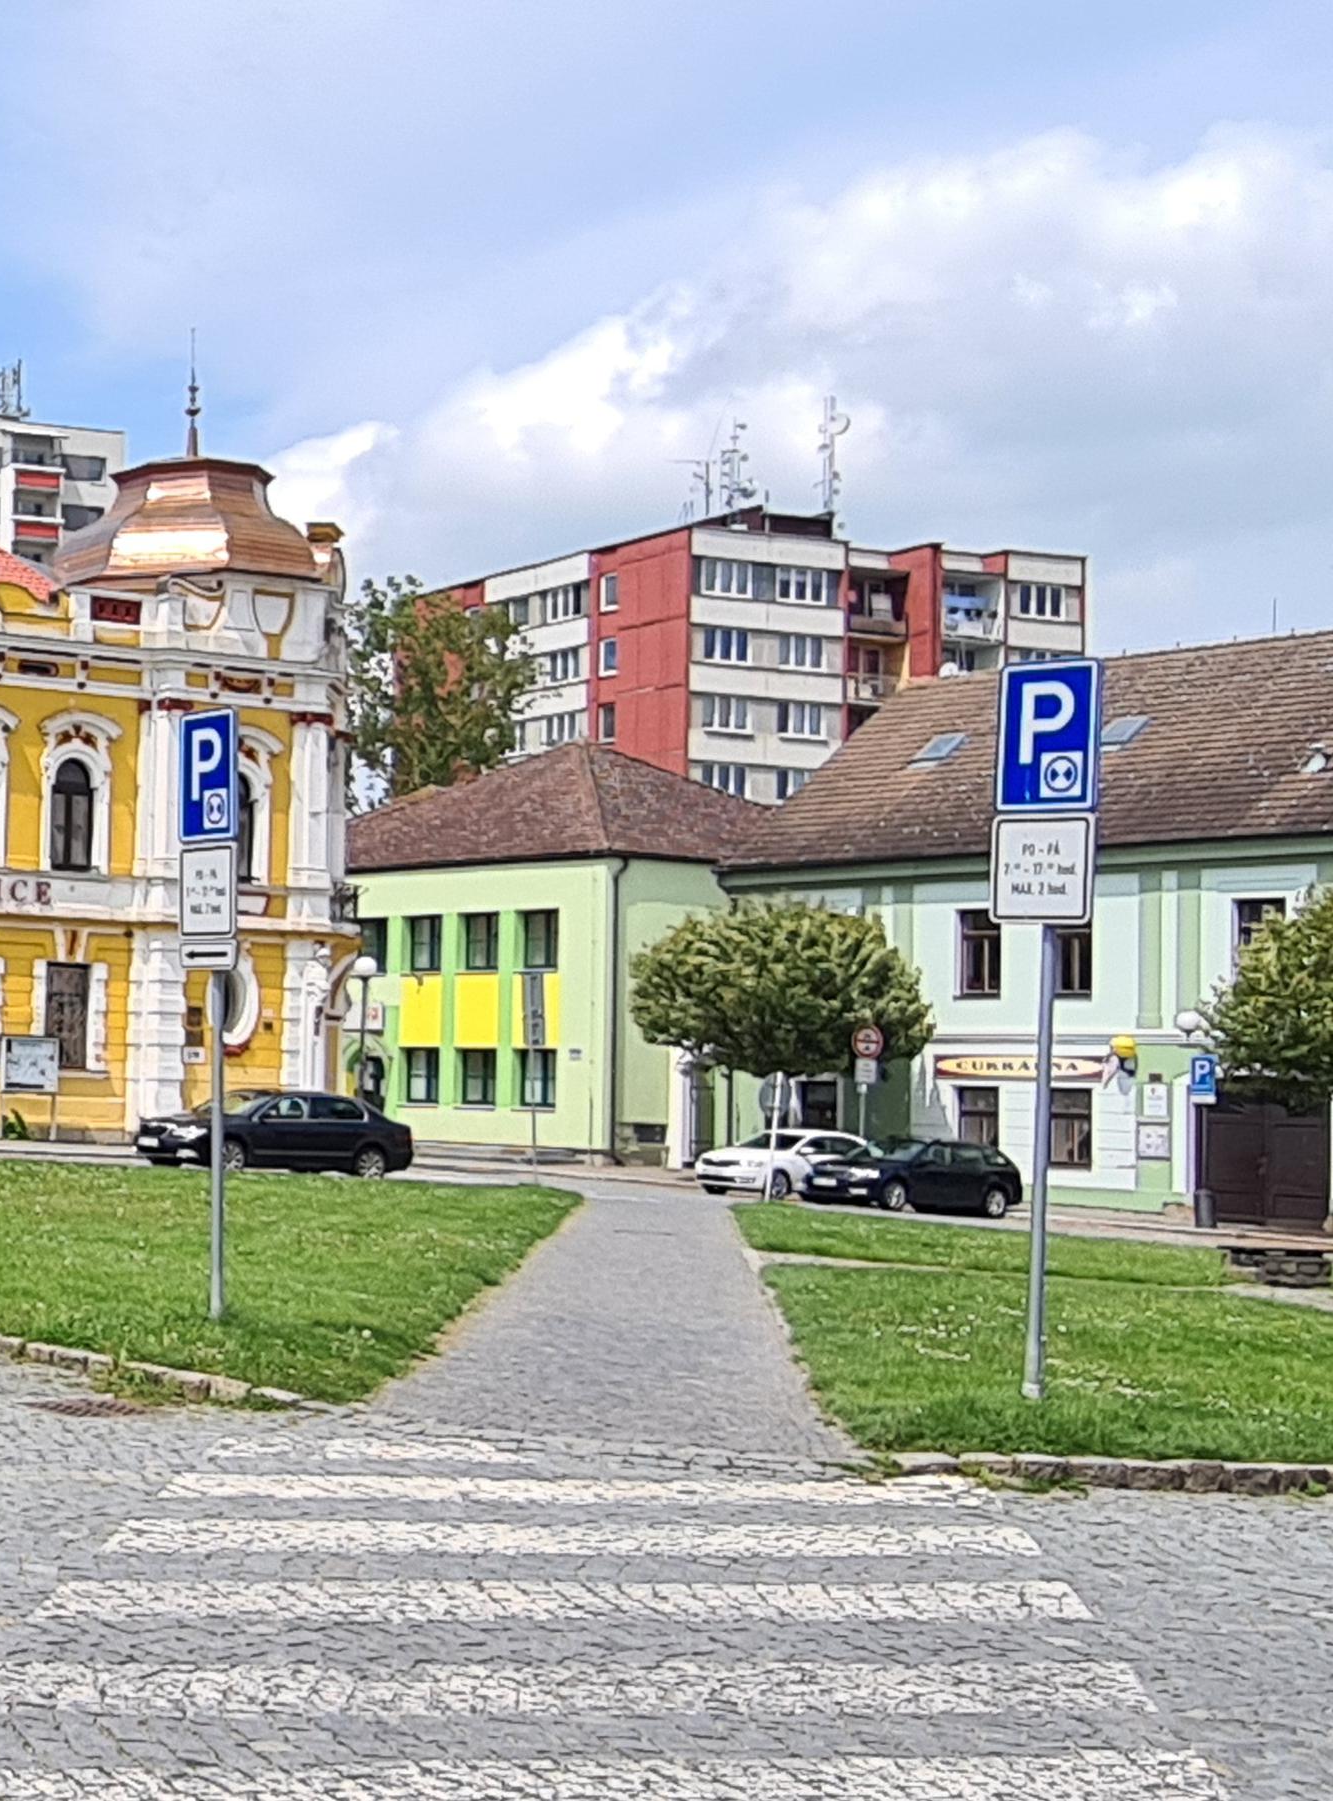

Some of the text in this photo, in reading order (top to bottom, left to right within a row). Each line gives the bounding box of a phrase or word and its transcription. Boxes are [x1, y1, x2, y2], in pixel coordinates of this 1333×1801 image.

[1019, 680, 1075, 765] P
[191, 727, 222, 801] P
[955, 1060, 1079, 1072] CUKRÁNA
